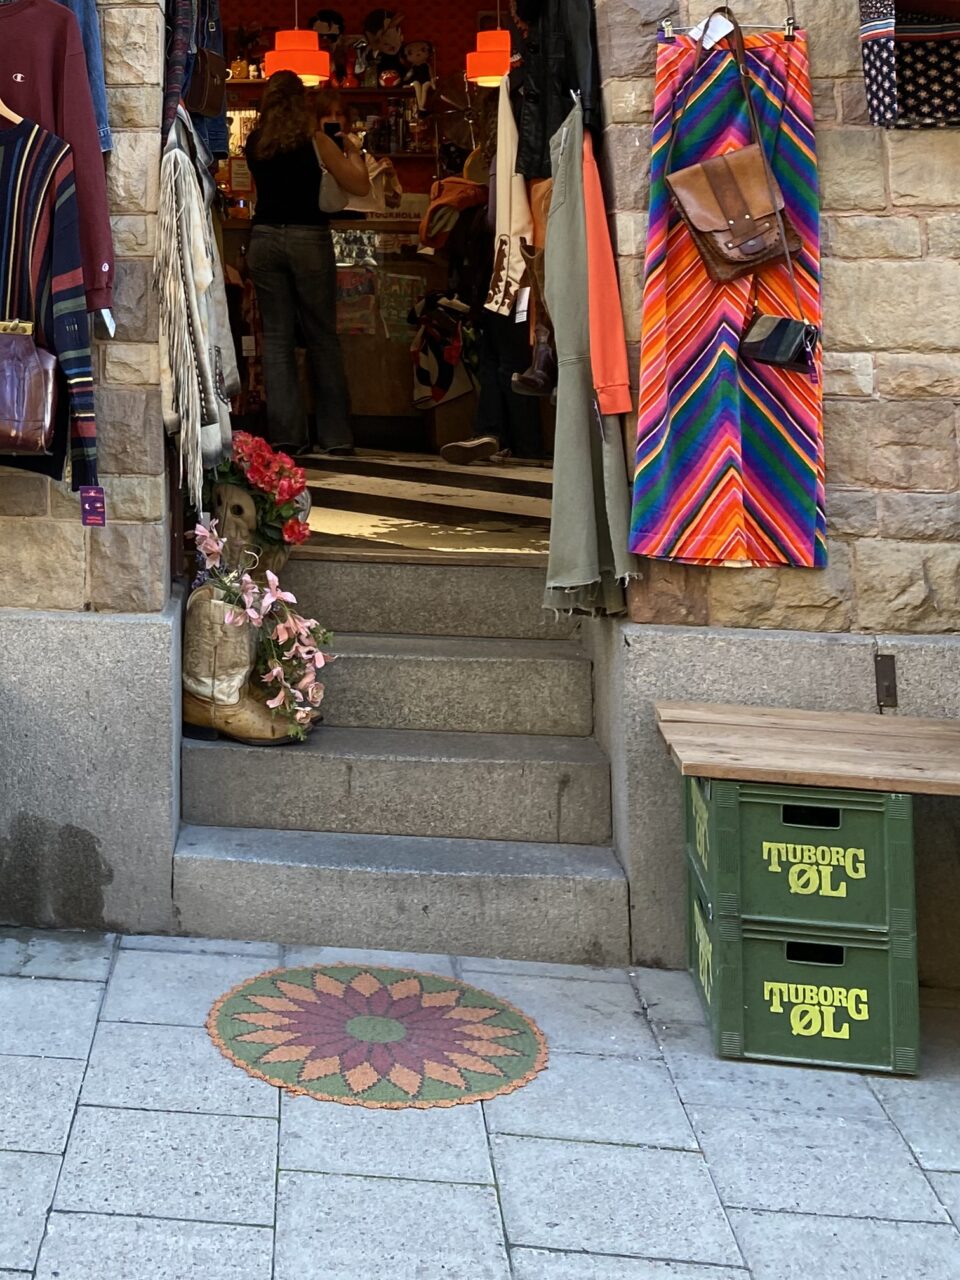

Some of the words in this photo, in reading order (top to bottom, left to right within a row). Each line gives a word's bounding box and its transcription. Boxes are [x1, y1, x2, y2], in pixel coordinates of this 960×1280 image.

[762, 841, 866, 879] TUBORG
[788, 863, 847, 898] ØL
[763, 981, 870, 1021] TUBORG
[790, 1004, 850, 1040] ØL
